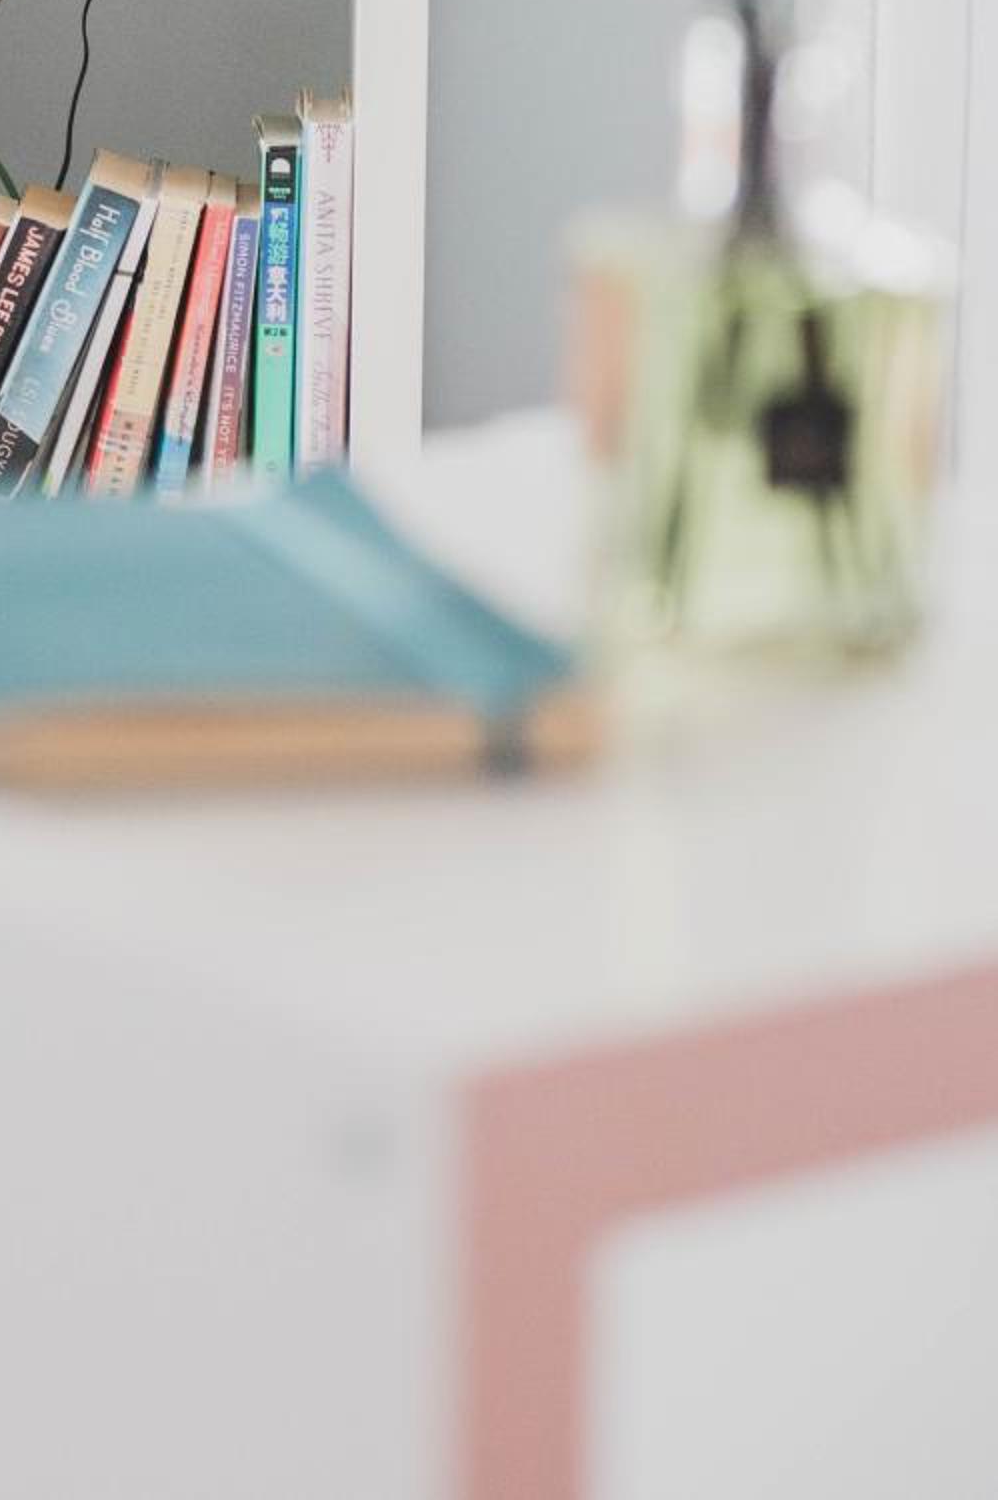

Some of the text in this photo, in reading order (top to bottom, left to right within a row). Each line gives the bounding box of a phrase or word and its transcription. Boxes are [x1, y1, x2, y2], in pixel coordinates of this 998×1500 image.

[315, 190, 336, 252] ANITA
[5, 224, 46, 289] JAMES
[33, 199, 122, 359] Half Blood Blues
[234, 233, 251, 278] SIMON
[216, 414, 232, 444] NOT
